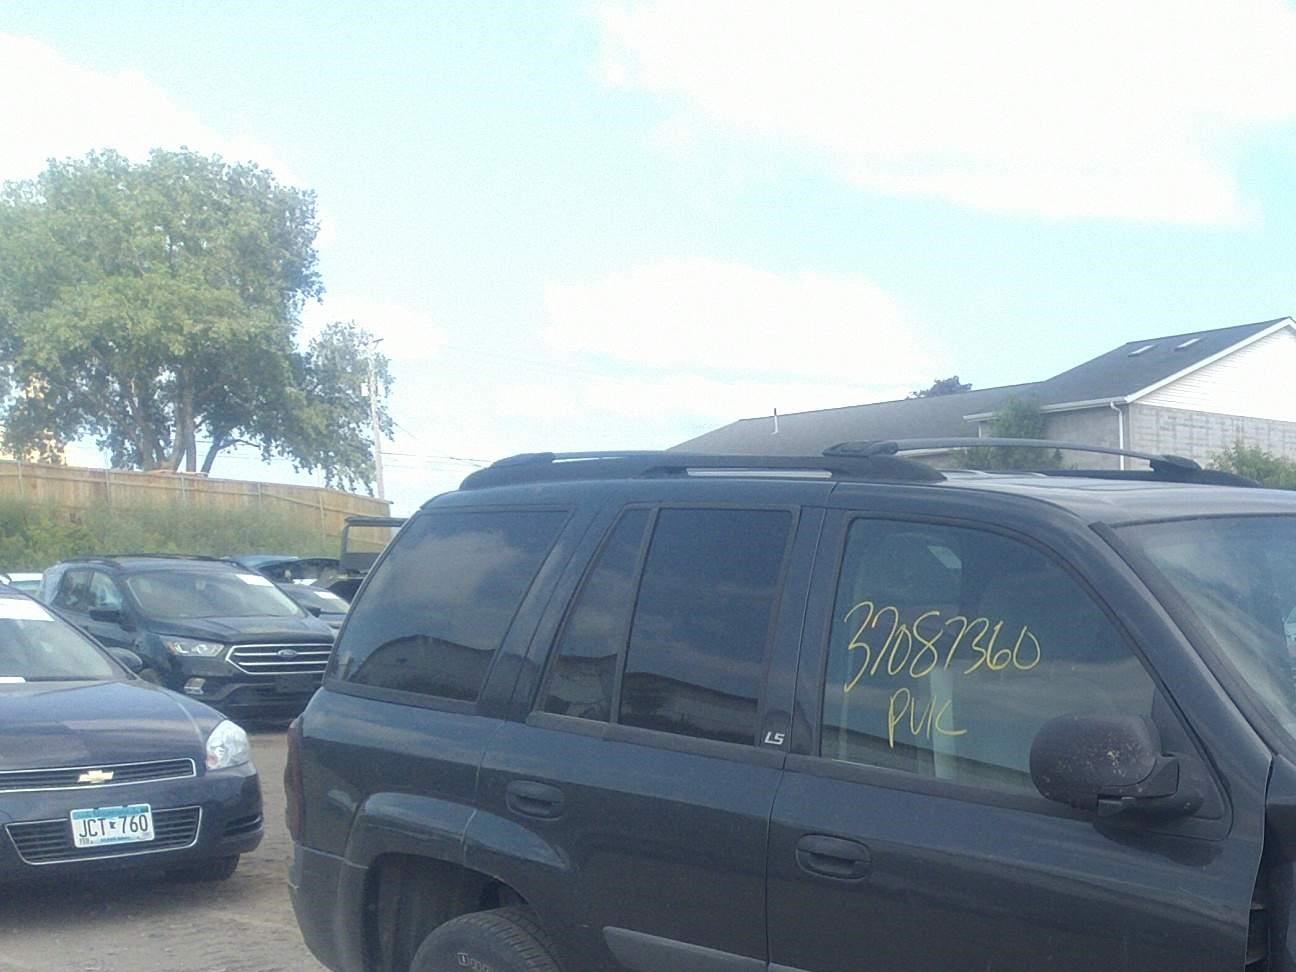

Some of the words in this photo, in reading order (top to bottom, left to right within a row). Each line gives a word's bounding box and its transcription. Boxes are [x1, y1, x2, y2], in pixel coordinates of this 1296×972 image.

[844, 601, 1041, 693] 37087360
[764, 731, 785, 745] LS
[79, 818, 106, 838] JCT
[118, 814, 149, 834] 760
